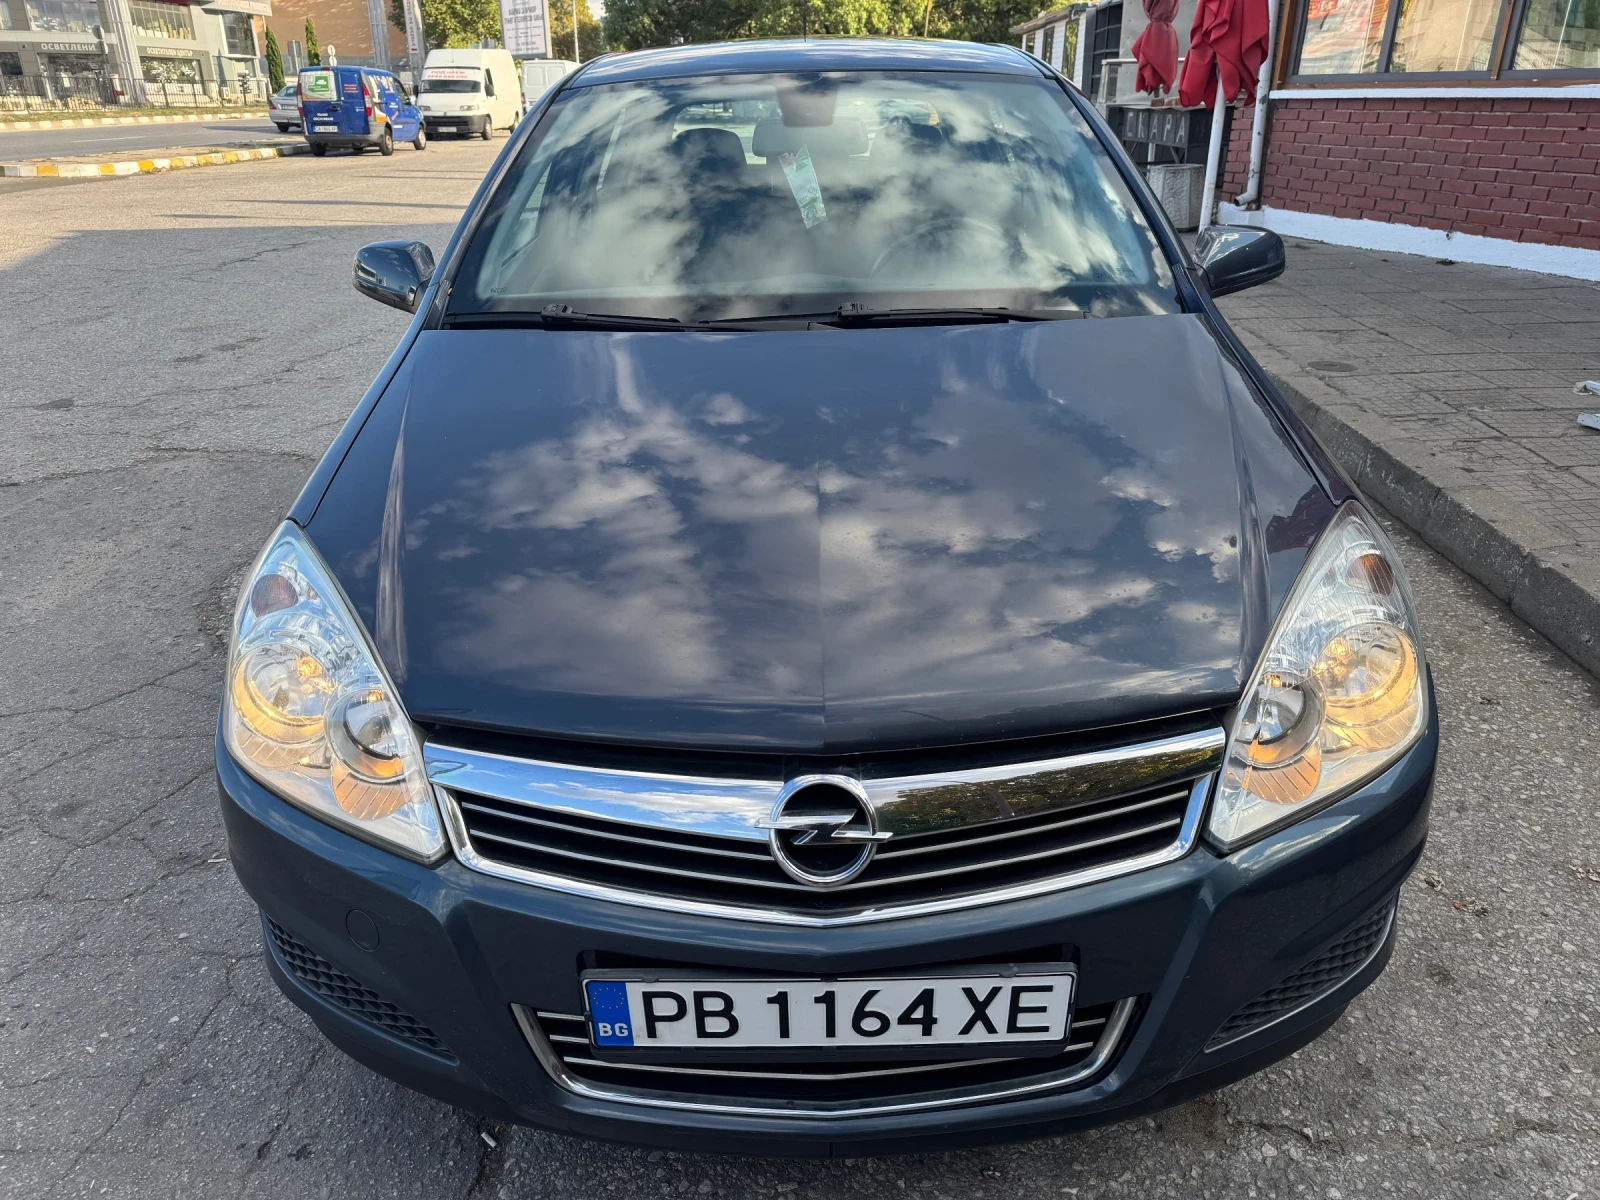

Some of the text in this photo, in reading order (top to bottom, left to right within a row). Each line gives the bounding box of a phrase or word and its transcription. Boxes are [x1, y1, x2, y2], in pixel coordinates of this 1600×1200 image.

[41, 43, 96, 51] ОСВЕТЛЕНИ
[1126, 111, 1185, 143] СКАРА
[641, 984, 1055, 1040] PB 1164 XE
[598, 1023, 628, 1037] BG
